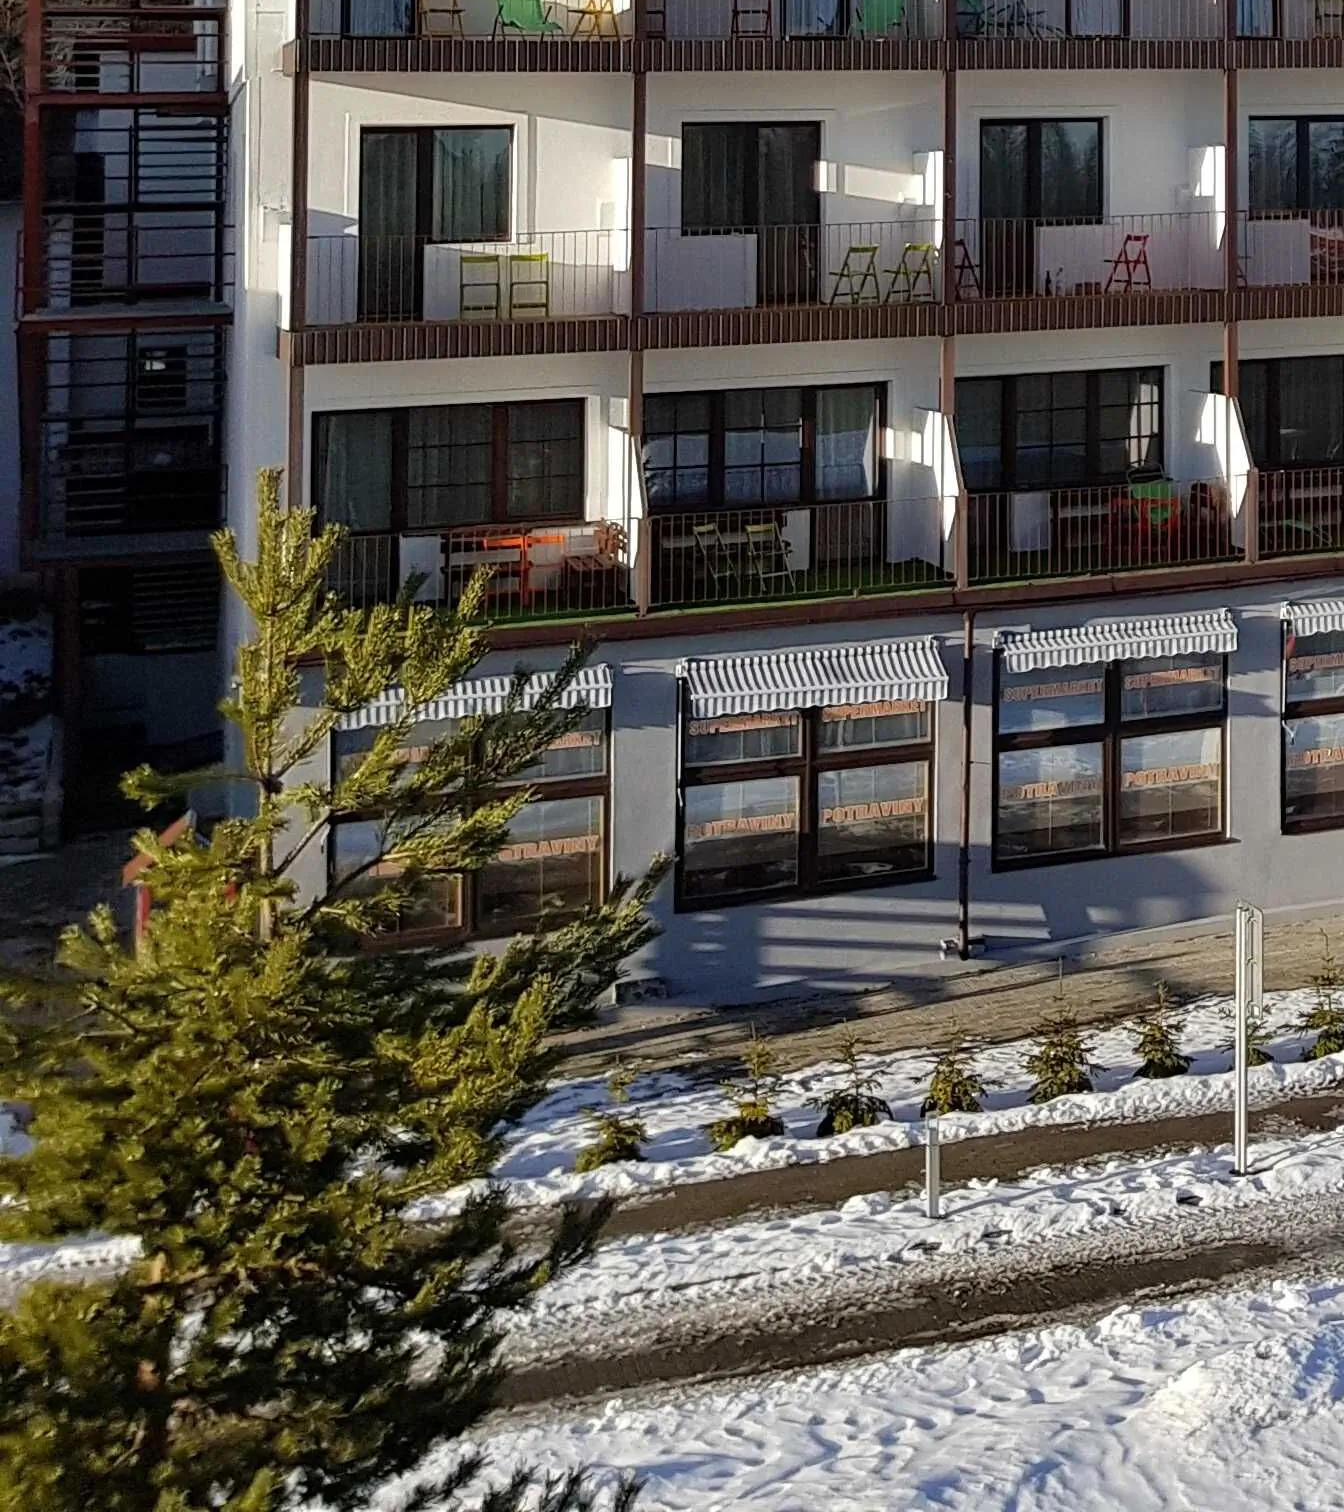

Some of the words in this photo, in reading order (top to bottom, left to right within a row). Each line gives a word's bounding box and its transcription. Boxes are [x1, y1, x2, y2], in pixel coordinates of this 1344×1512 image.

[822, 700, 926, 722] SUPERMARKET
[1124, 762, 1220, 787] POTRAVINY
[823, 798, 925, 823] POTRAVINY
[497, 835, 600, 861] OTRAVINY
